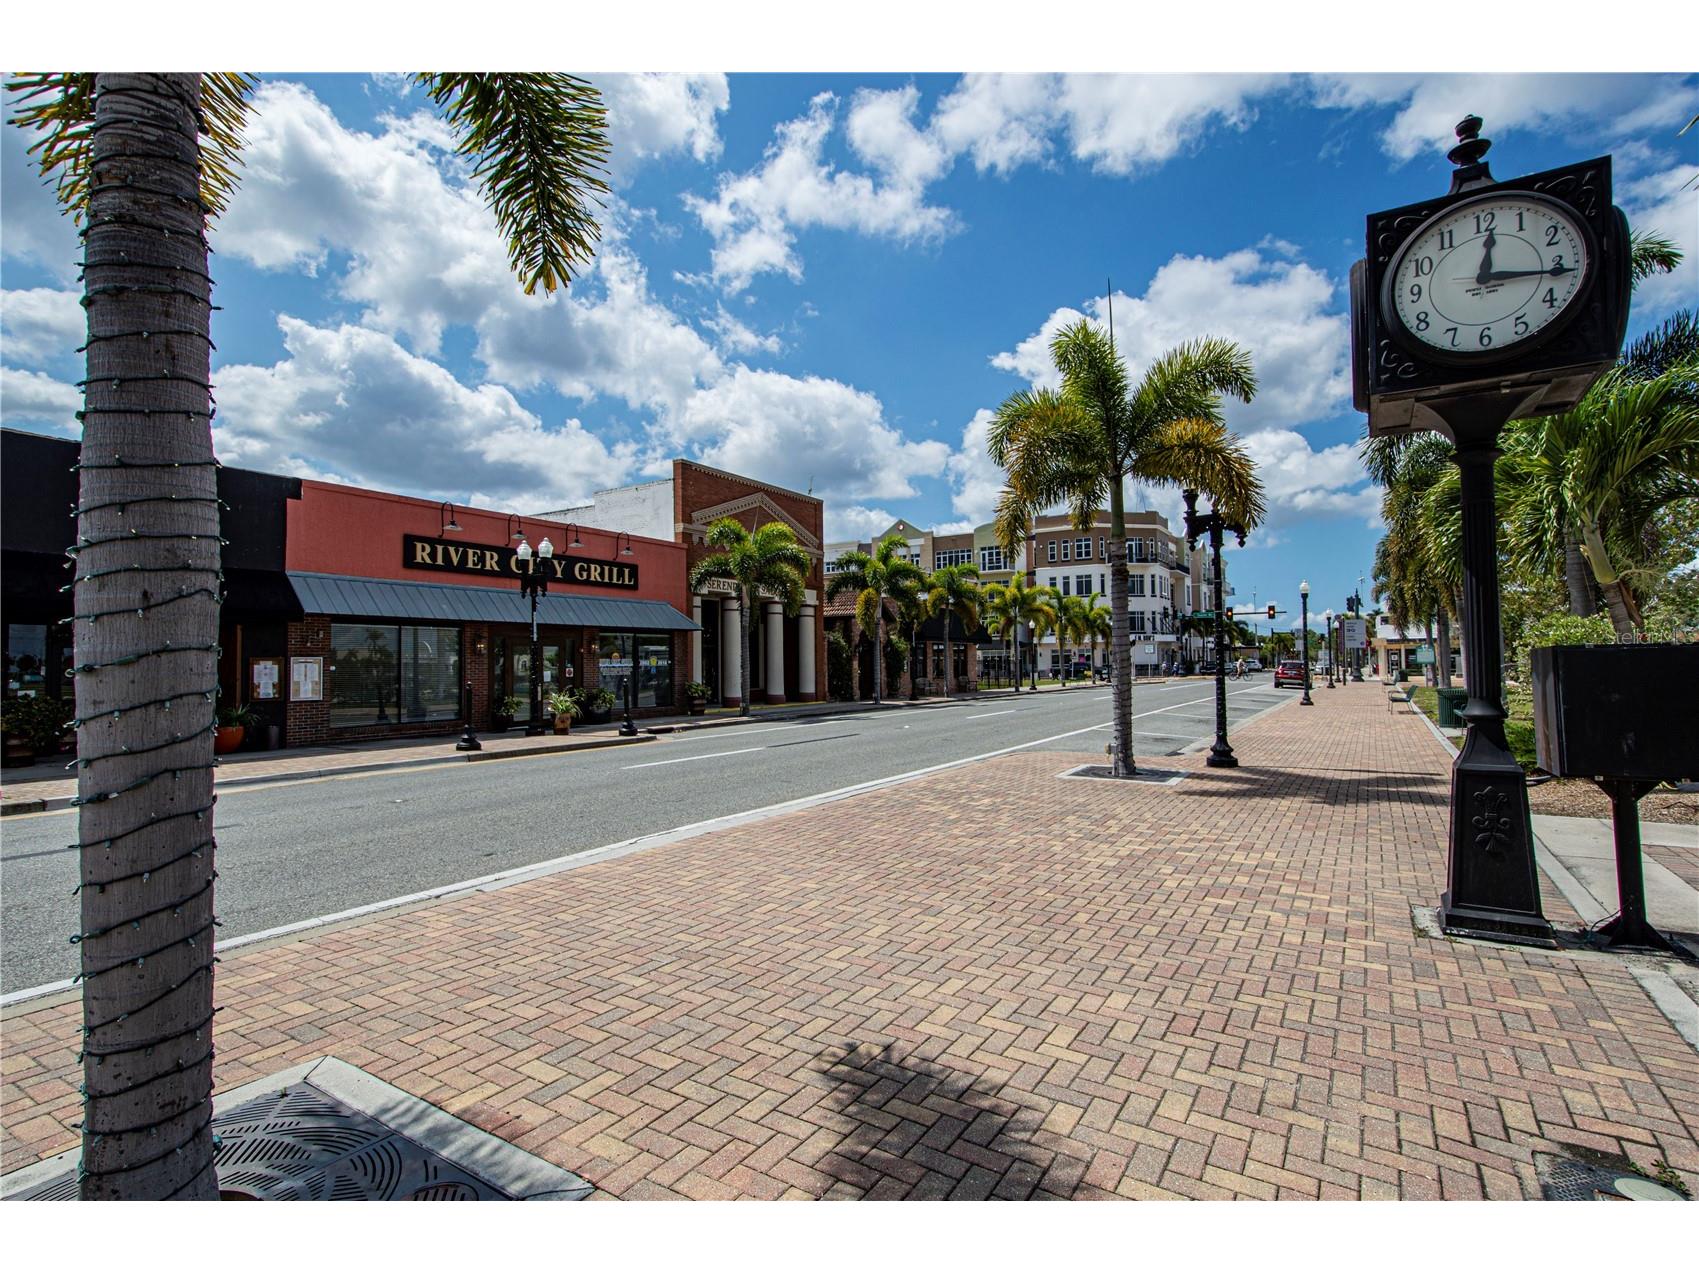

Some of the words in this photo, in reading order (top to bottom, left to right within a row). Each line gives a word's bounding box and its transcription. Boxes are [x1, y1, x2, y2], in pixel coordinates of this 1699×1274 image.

[1473, 212, 1497, 234] 12
[1516, 212, 1526, 232] 1
[1438, 229, 1455, 251] 11
[1545, 225, 1560, 247] 2
[1413, 256, 1433, 278] 10
[1552, 255, 1564, 275] 3
[1410, 284, 1422, 303] 9
[1542, 287, 1557, 308] 4
[1416, 311, 1430, 331] 8
[1514, 313, 1529, 335] 5
[1443, 328, 1461, 347] 7
[1479, 326, 1492, 347] 6
[413, 541, 501, 572] RIVER
[510, 554, 566, 578] CIY
[574, 562, 635, 586] GRILL
